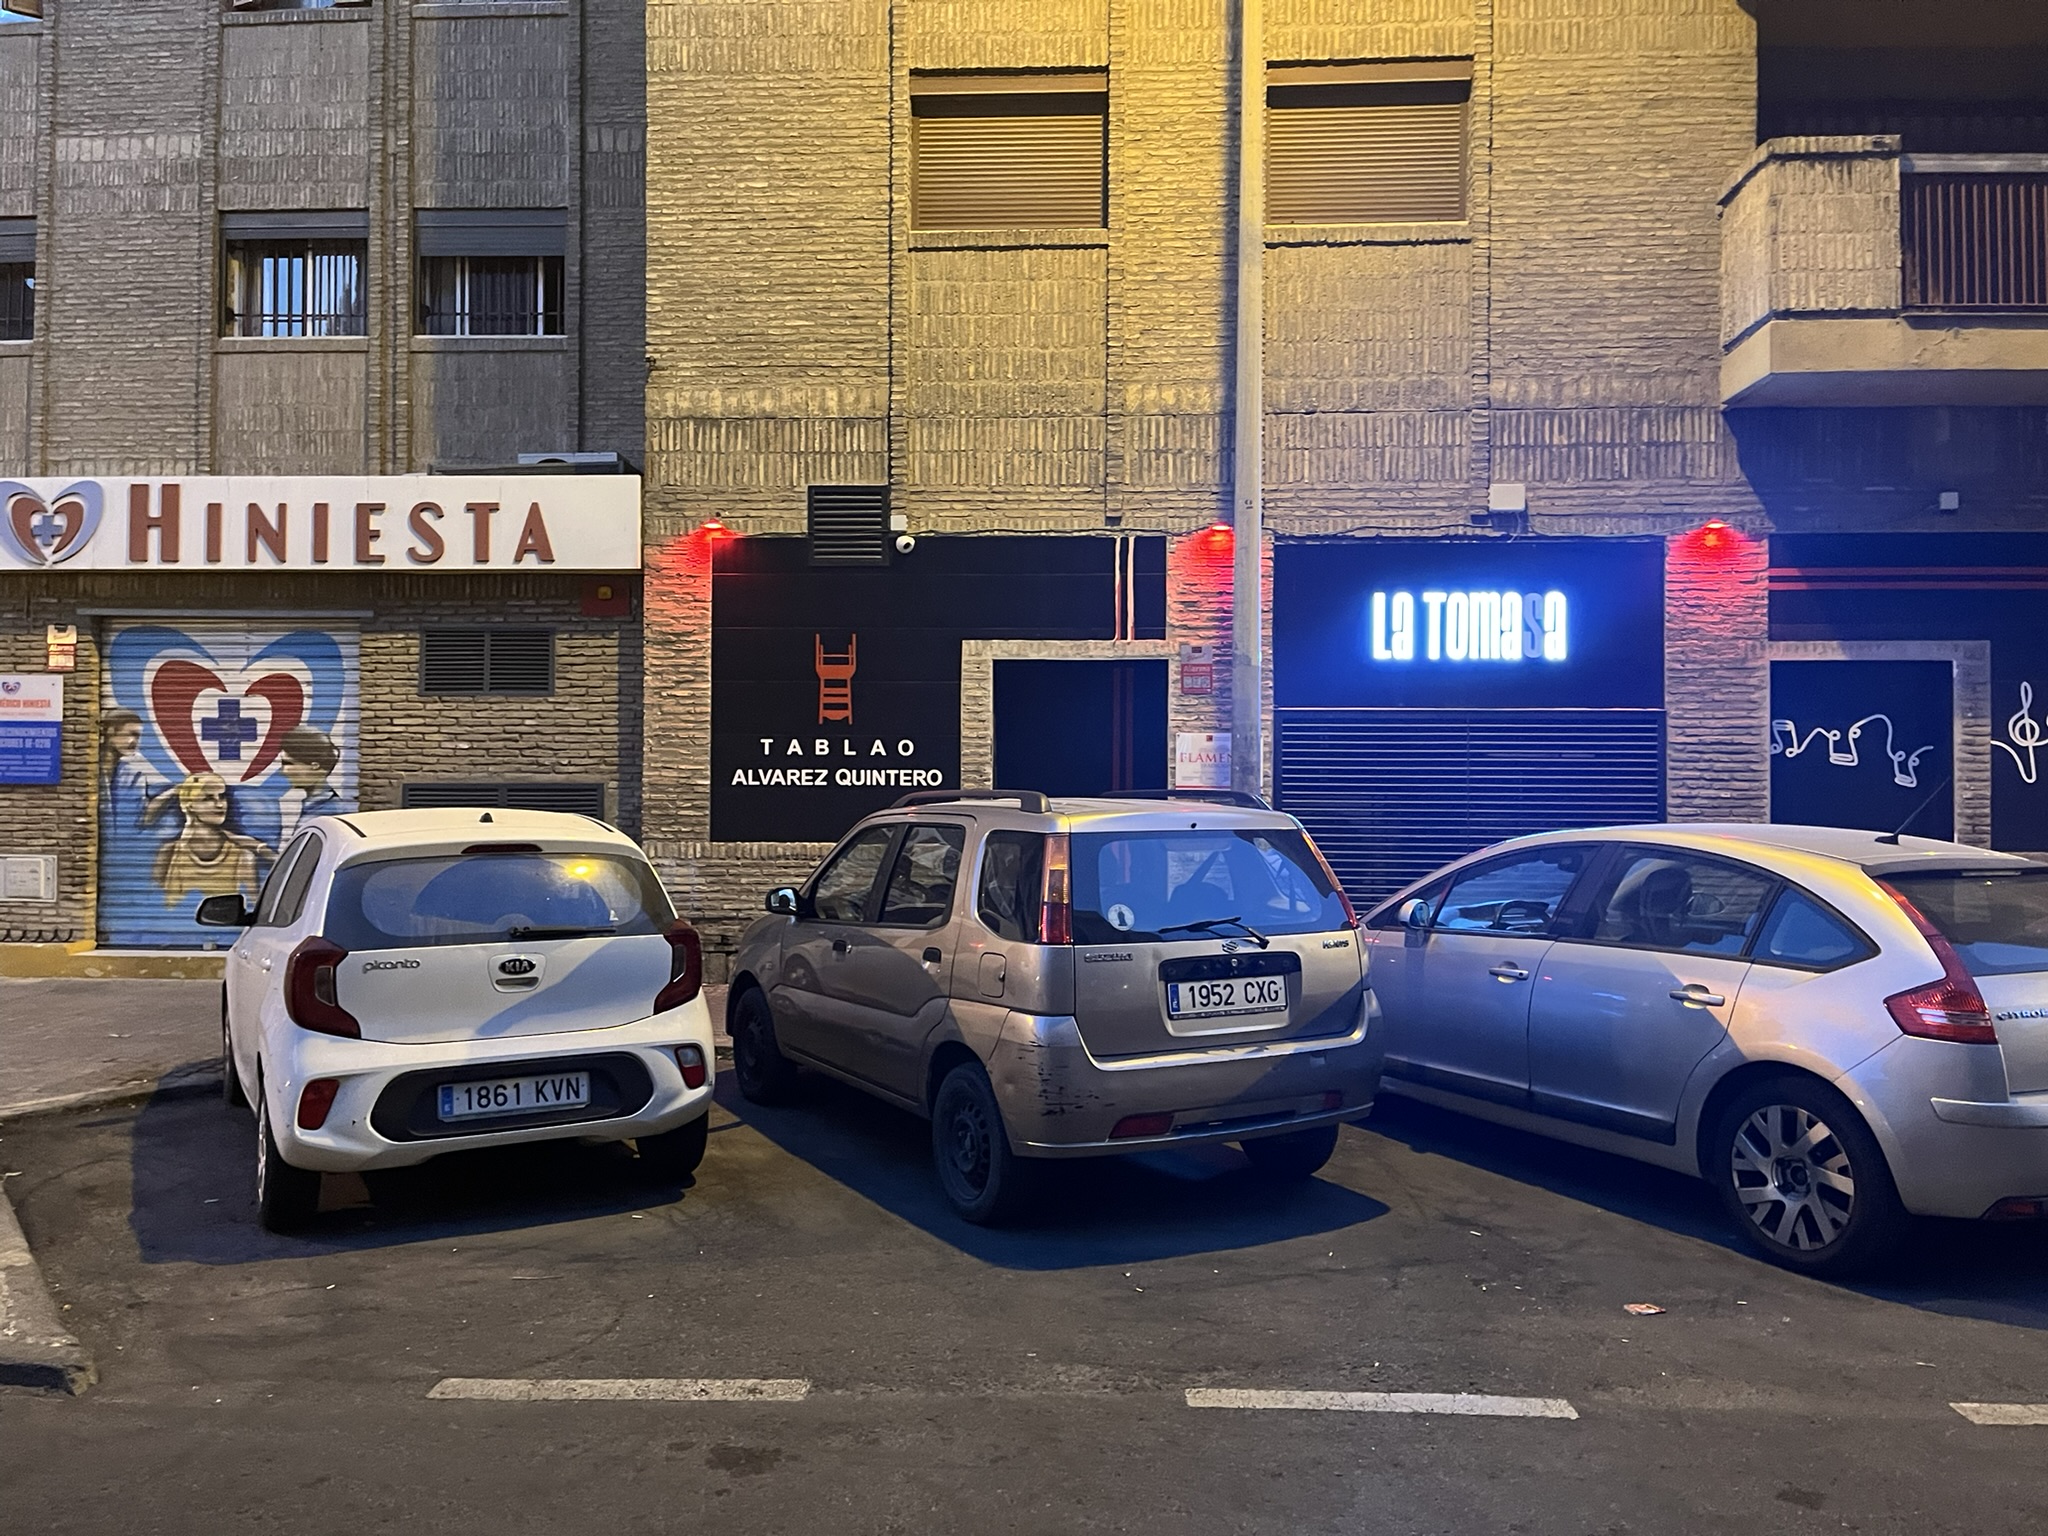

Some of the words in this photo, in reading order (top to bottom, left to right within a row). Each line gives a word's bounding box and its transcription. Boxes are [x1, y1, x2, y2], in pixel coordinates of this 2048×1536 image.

[128, 483, 555, 563] HINIESTA
[760, 738, 915, 756] TABLAO
[731, 769, 829, 786] ALVAREZ
[835, 768, 943, 787] QUINTERO
[362, 959, 421, 974] picanto
[505, 960, 530, 972] KIA
[1188, 983, 1236, 1009] 1952
[1244, 980, 1279, 1004] CXG
[464, 1082, 521, 1110] 1861
[535, 1077, 581, 1103] KVN
